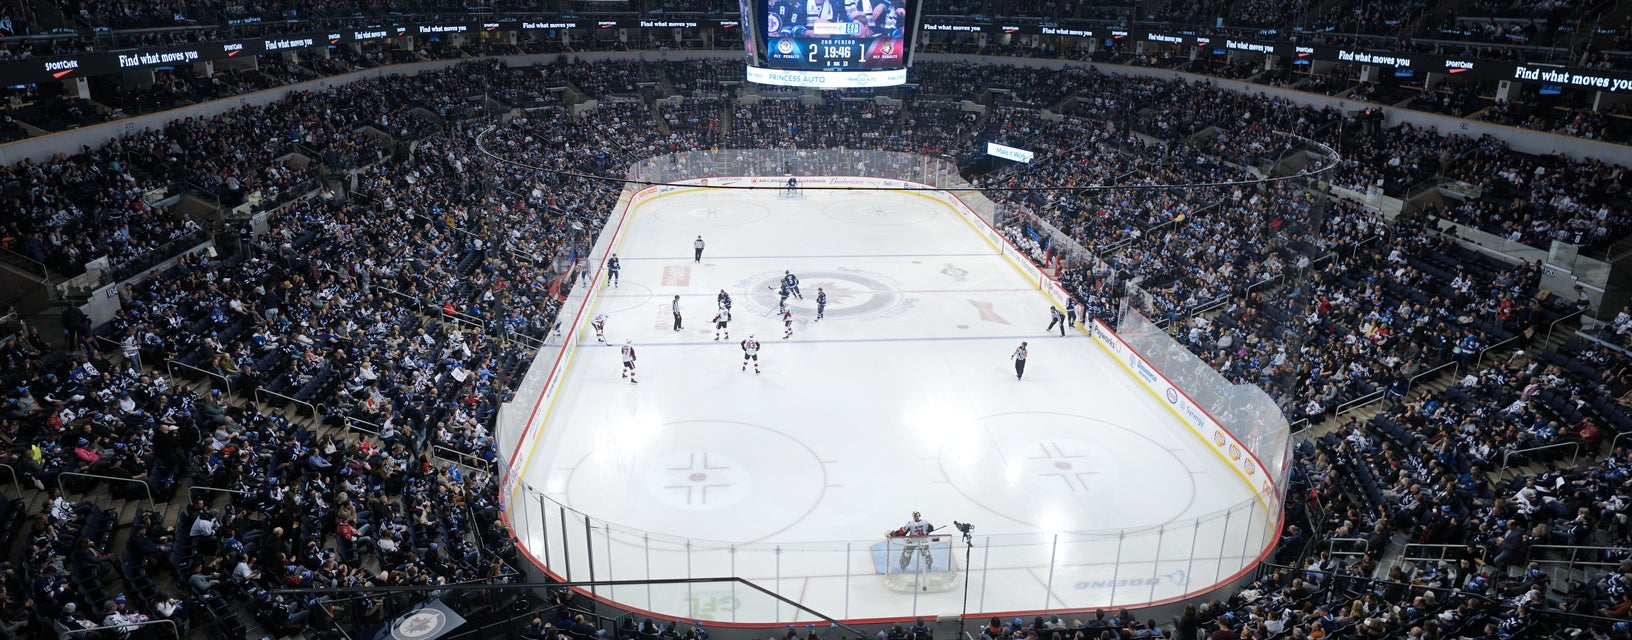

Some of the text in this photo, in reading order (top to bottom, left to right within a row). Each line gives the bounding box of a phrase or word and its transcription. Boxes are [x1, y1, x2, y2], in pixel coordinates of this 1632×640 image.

[265, 40, 277, 50] Find
[278, 39, 290, 49] what
[304, 38, 312, 48] you
[824, 46, 850, 58] 19:46
[1226, 40, 1236, 48] Find
[1237, 42, 1248, 50] what
[1264, 45, 1274, 54] you
[119, 50, 198, 68] Find what moves you
[809, 44, 818, 62] 2
[858, 44, 866, 62] 1
[1339, 50, 1410, 68] Find what moves you
[45, 60, 78, 72] SPORTCHEK
[769, 74, 802, 82] PRINCESS
[1515, 66, 1632, 92] Find what moves you
[746, 341, 756, 349] 93
[1094, 324, 1116, 350] Payworks
